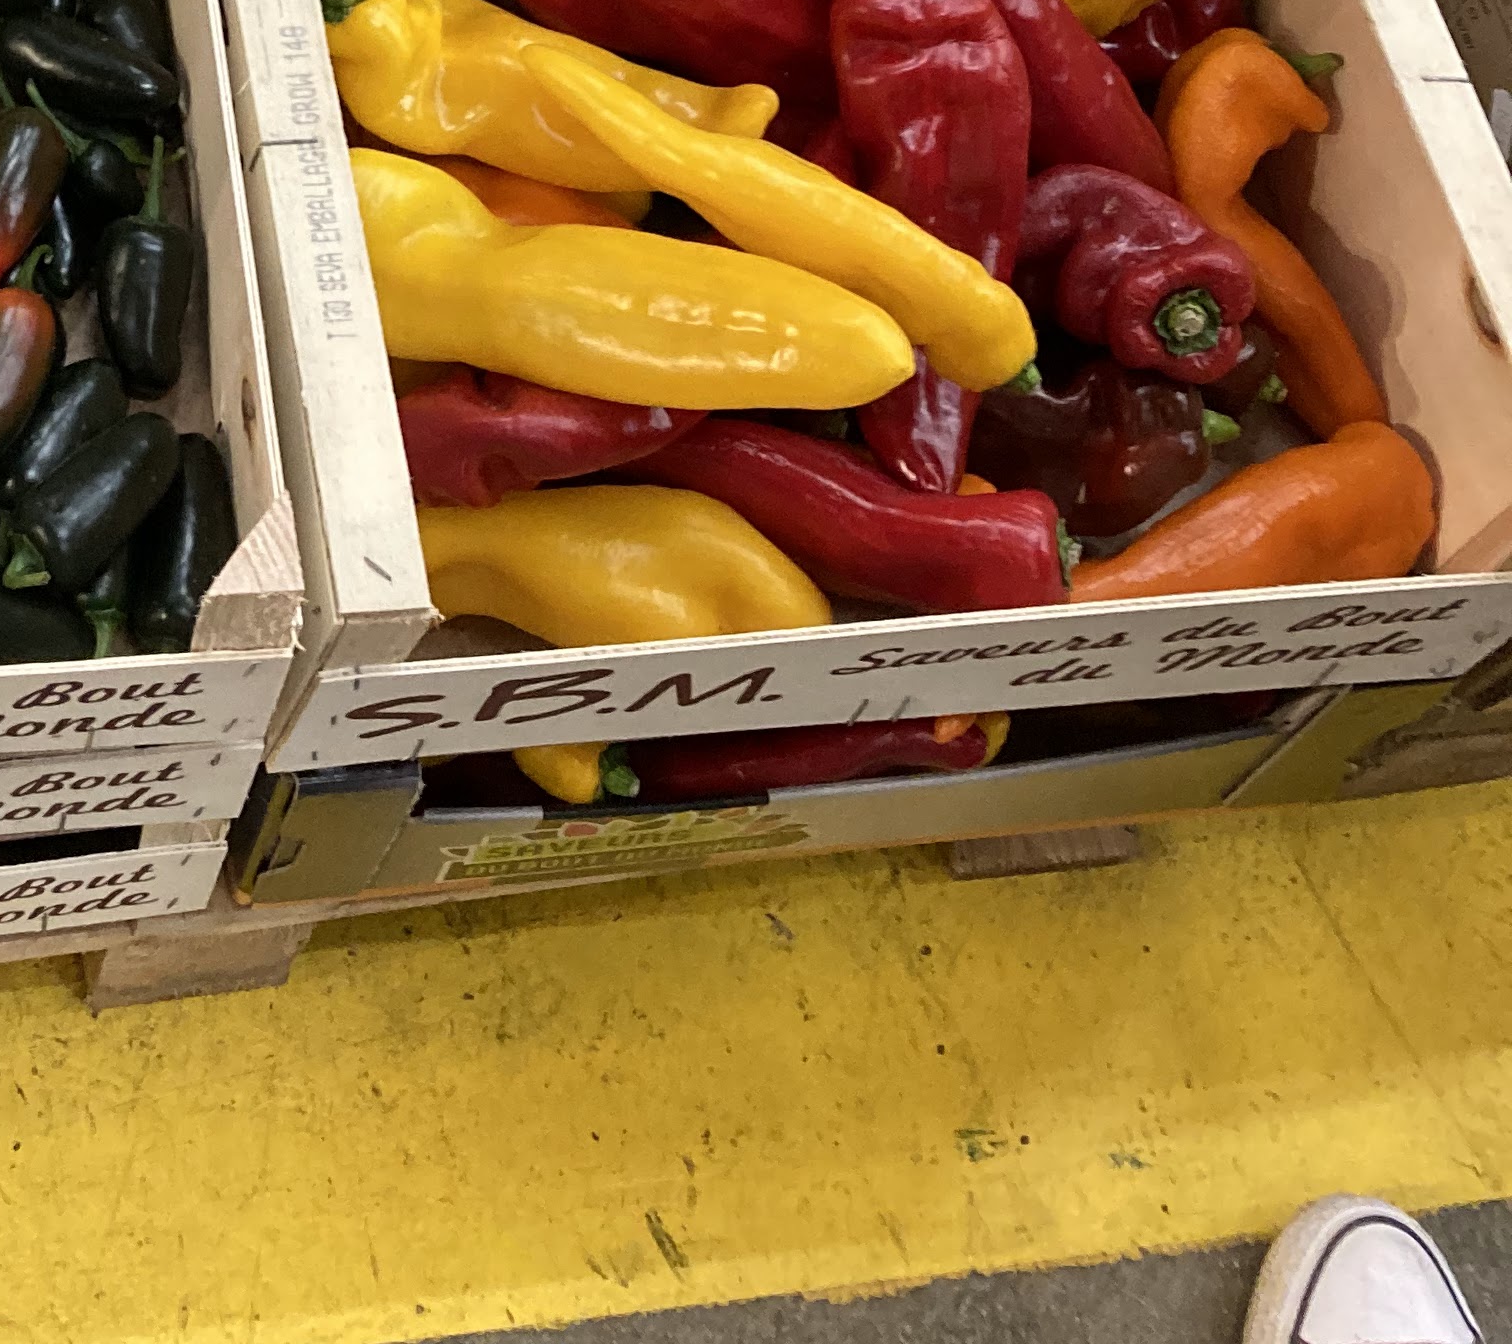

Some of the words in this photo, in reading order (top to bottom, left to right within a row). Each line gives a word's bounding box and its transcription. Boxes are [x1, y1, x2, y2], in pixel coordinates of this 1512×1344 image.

[288, 72, 320, 127] GROW
[314, 250, 349, 296] SEVA
[831, 630, 1132, 676] Saveurs
[1160, 616, 1261, 646] du
[1286, 596, 1469, 636] Bout
[1010, 656, 1112, 686] du
[1152, 628, 1427, 674] Monde
[13, 672, 204, 707] Bout
[344, 664, 781, 738] S.B.M.
[11, 761, 185, 797] Bout
[488, 828, 693, 859] SAVEURS
[0, 863, 157, 901] Bout
